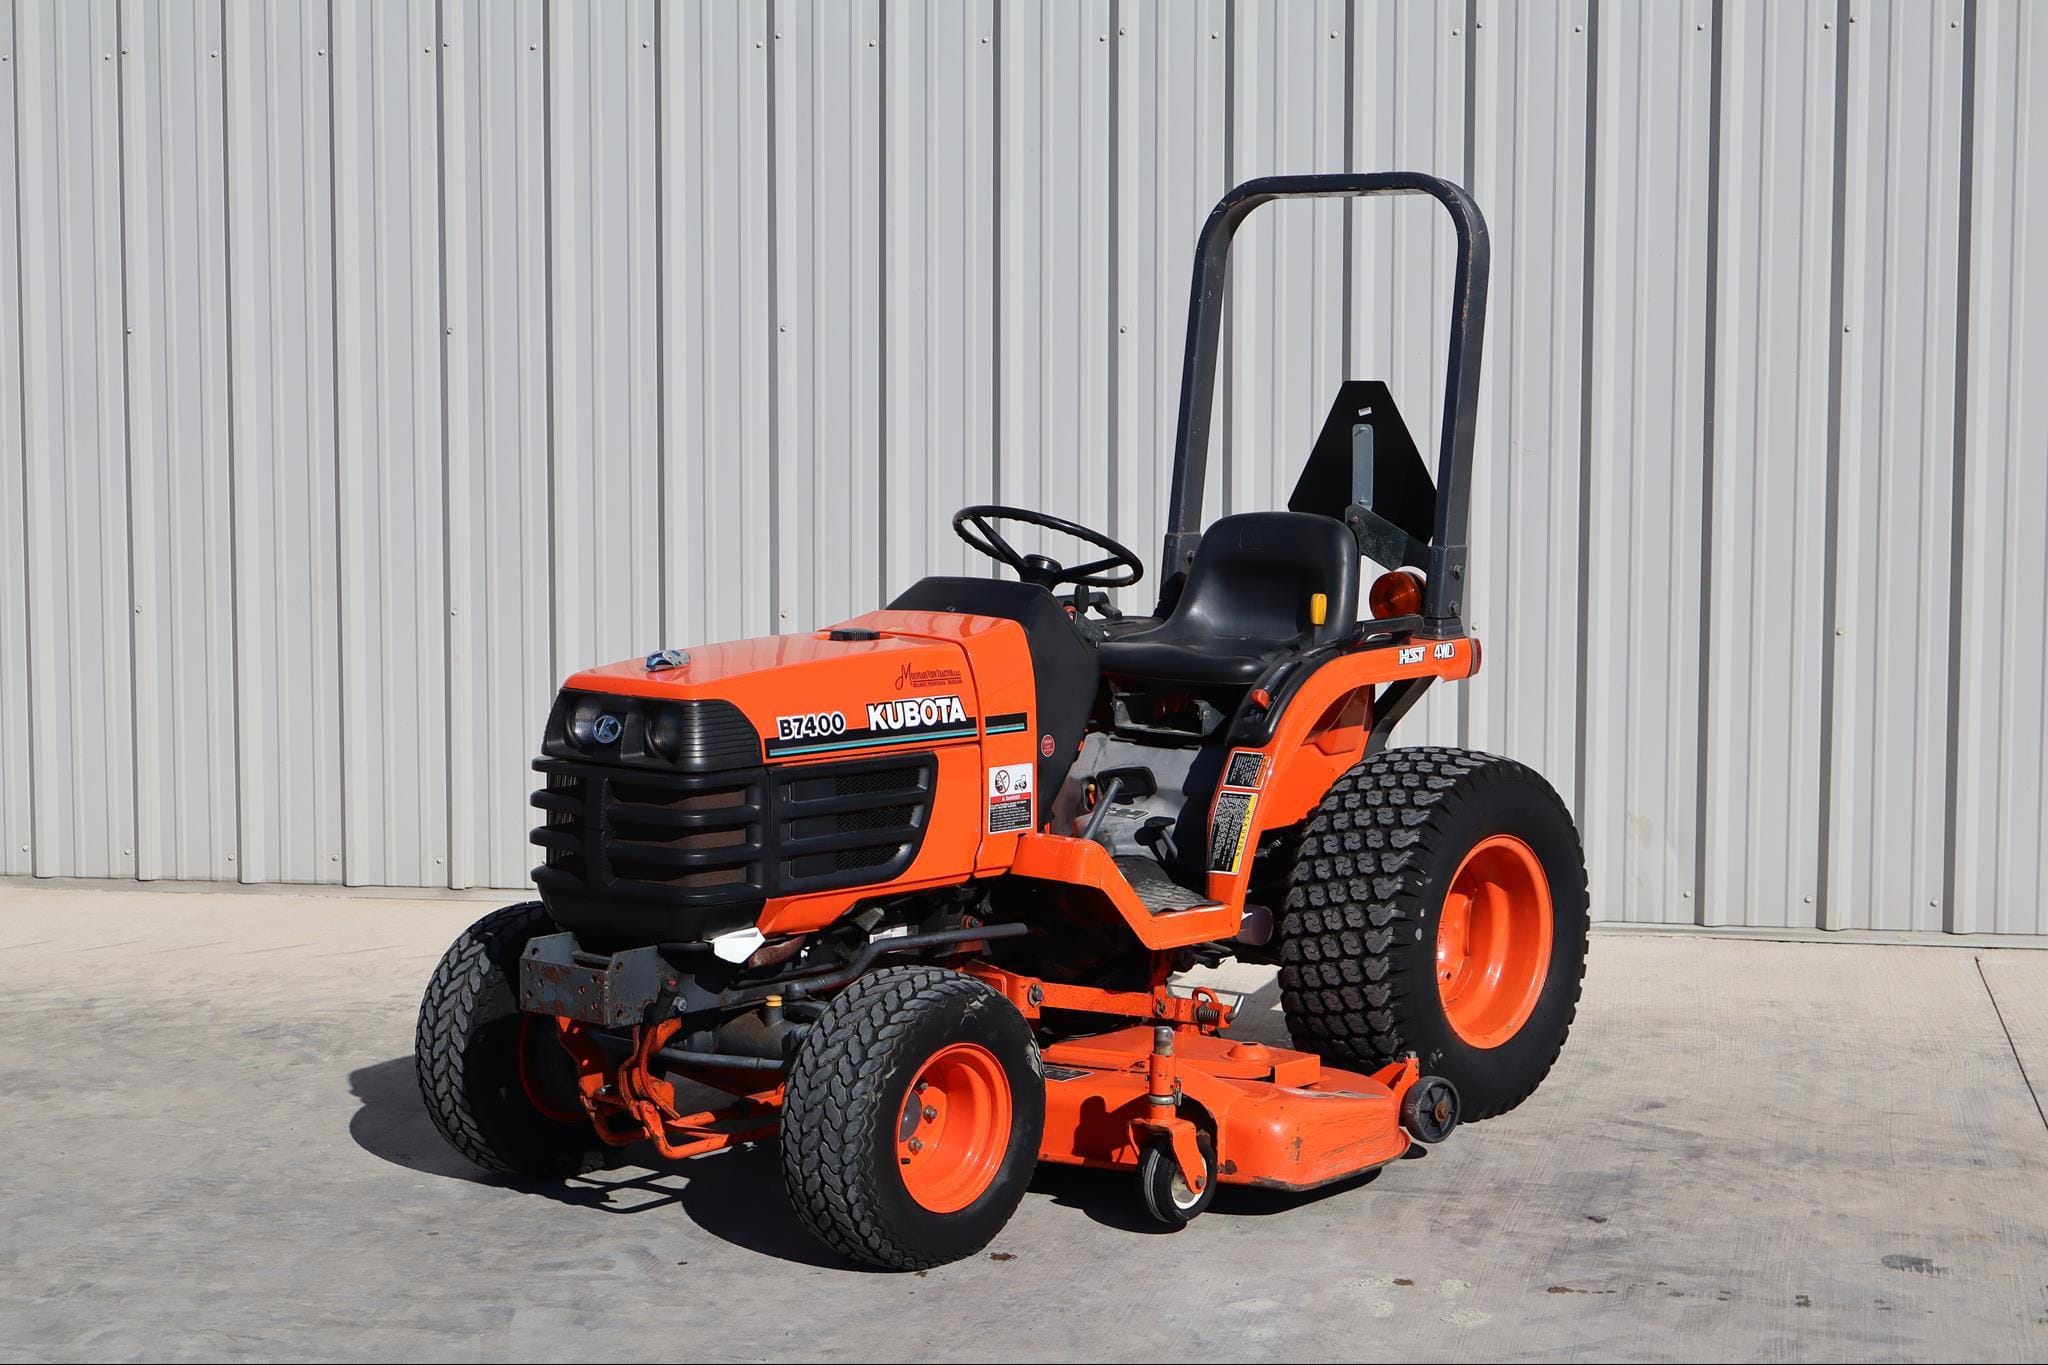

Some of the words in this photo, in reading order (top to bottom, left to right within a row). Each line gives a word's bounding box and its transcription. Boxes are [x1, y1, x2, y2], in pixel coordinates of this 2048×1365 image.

[1398, 646, 1426, 665] HST
[1433, 642, 1455, 660] 4WD
[777, 712, 846, 739] B7400
[867, 696, 967, 731] KUBOTA
